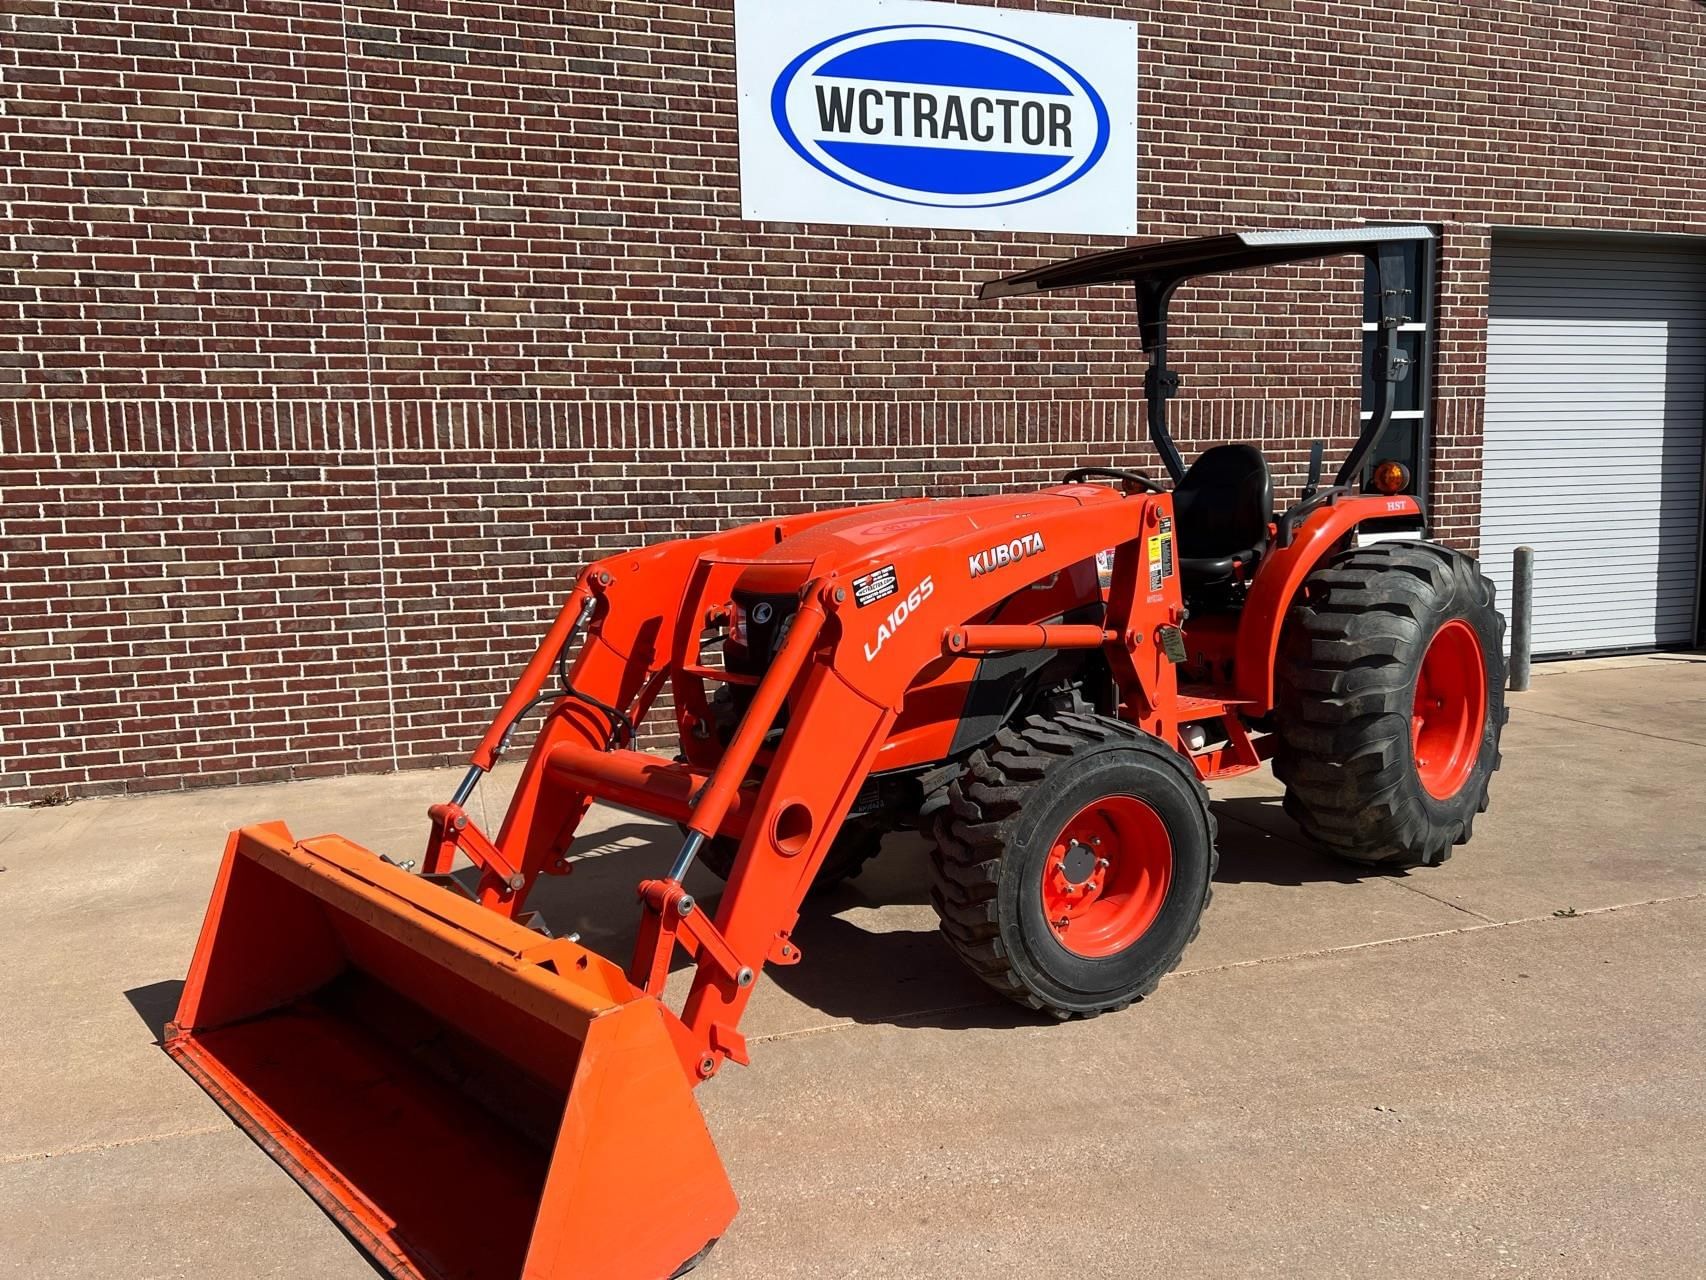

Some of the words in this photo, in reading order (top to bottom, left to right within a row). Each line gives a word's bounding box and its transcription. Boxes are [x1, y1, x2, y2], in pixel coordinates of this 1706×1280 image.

[815, 85, 1073, 148] WCTRACTOR
[1386, 501, 1406, 512] HST
[968, 531, 1045, 578] KUBOTA
[863, 575, 934, 662] LA1065
